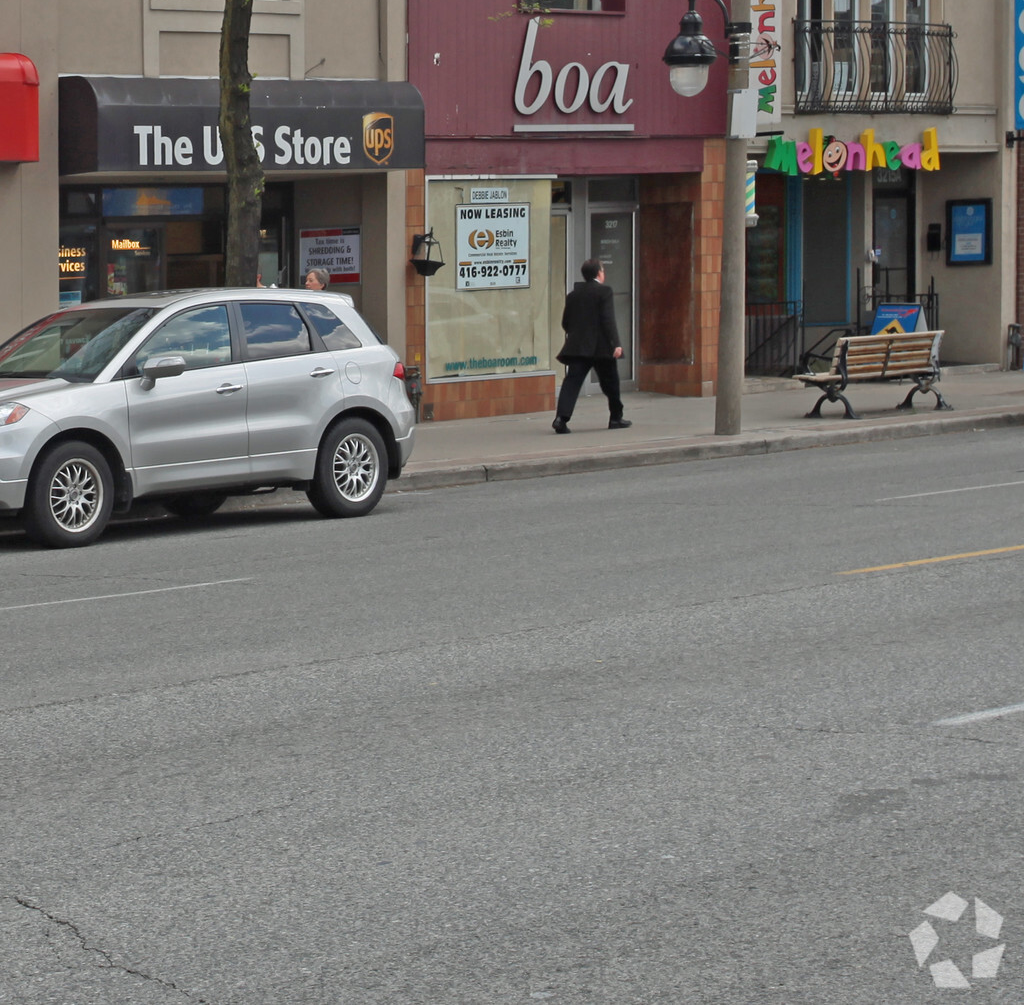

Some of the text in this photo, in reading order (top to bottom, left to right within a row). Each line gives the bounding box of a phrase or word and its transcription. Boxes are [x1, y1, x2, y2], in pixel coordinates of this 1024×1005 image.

[514, 16, 634, 115] boa
[133, 125, 352, 166] The US Store
[365, 128, 392, 156] ups
[472, 190, 489, 200] DEBBIE
[460, 207, 526, 220] NOW LEASING
[496, 229, 514, 238] Esbin
[111, 239, 140, 250] Mailbox
[496, 239, 517, 248] Realty
[308, 245, 352, 255] SHREDDING &
[306, 257, 354, 267] STORAGE TIME!
[445, 355, 538, 371] www.theboaroom.com
